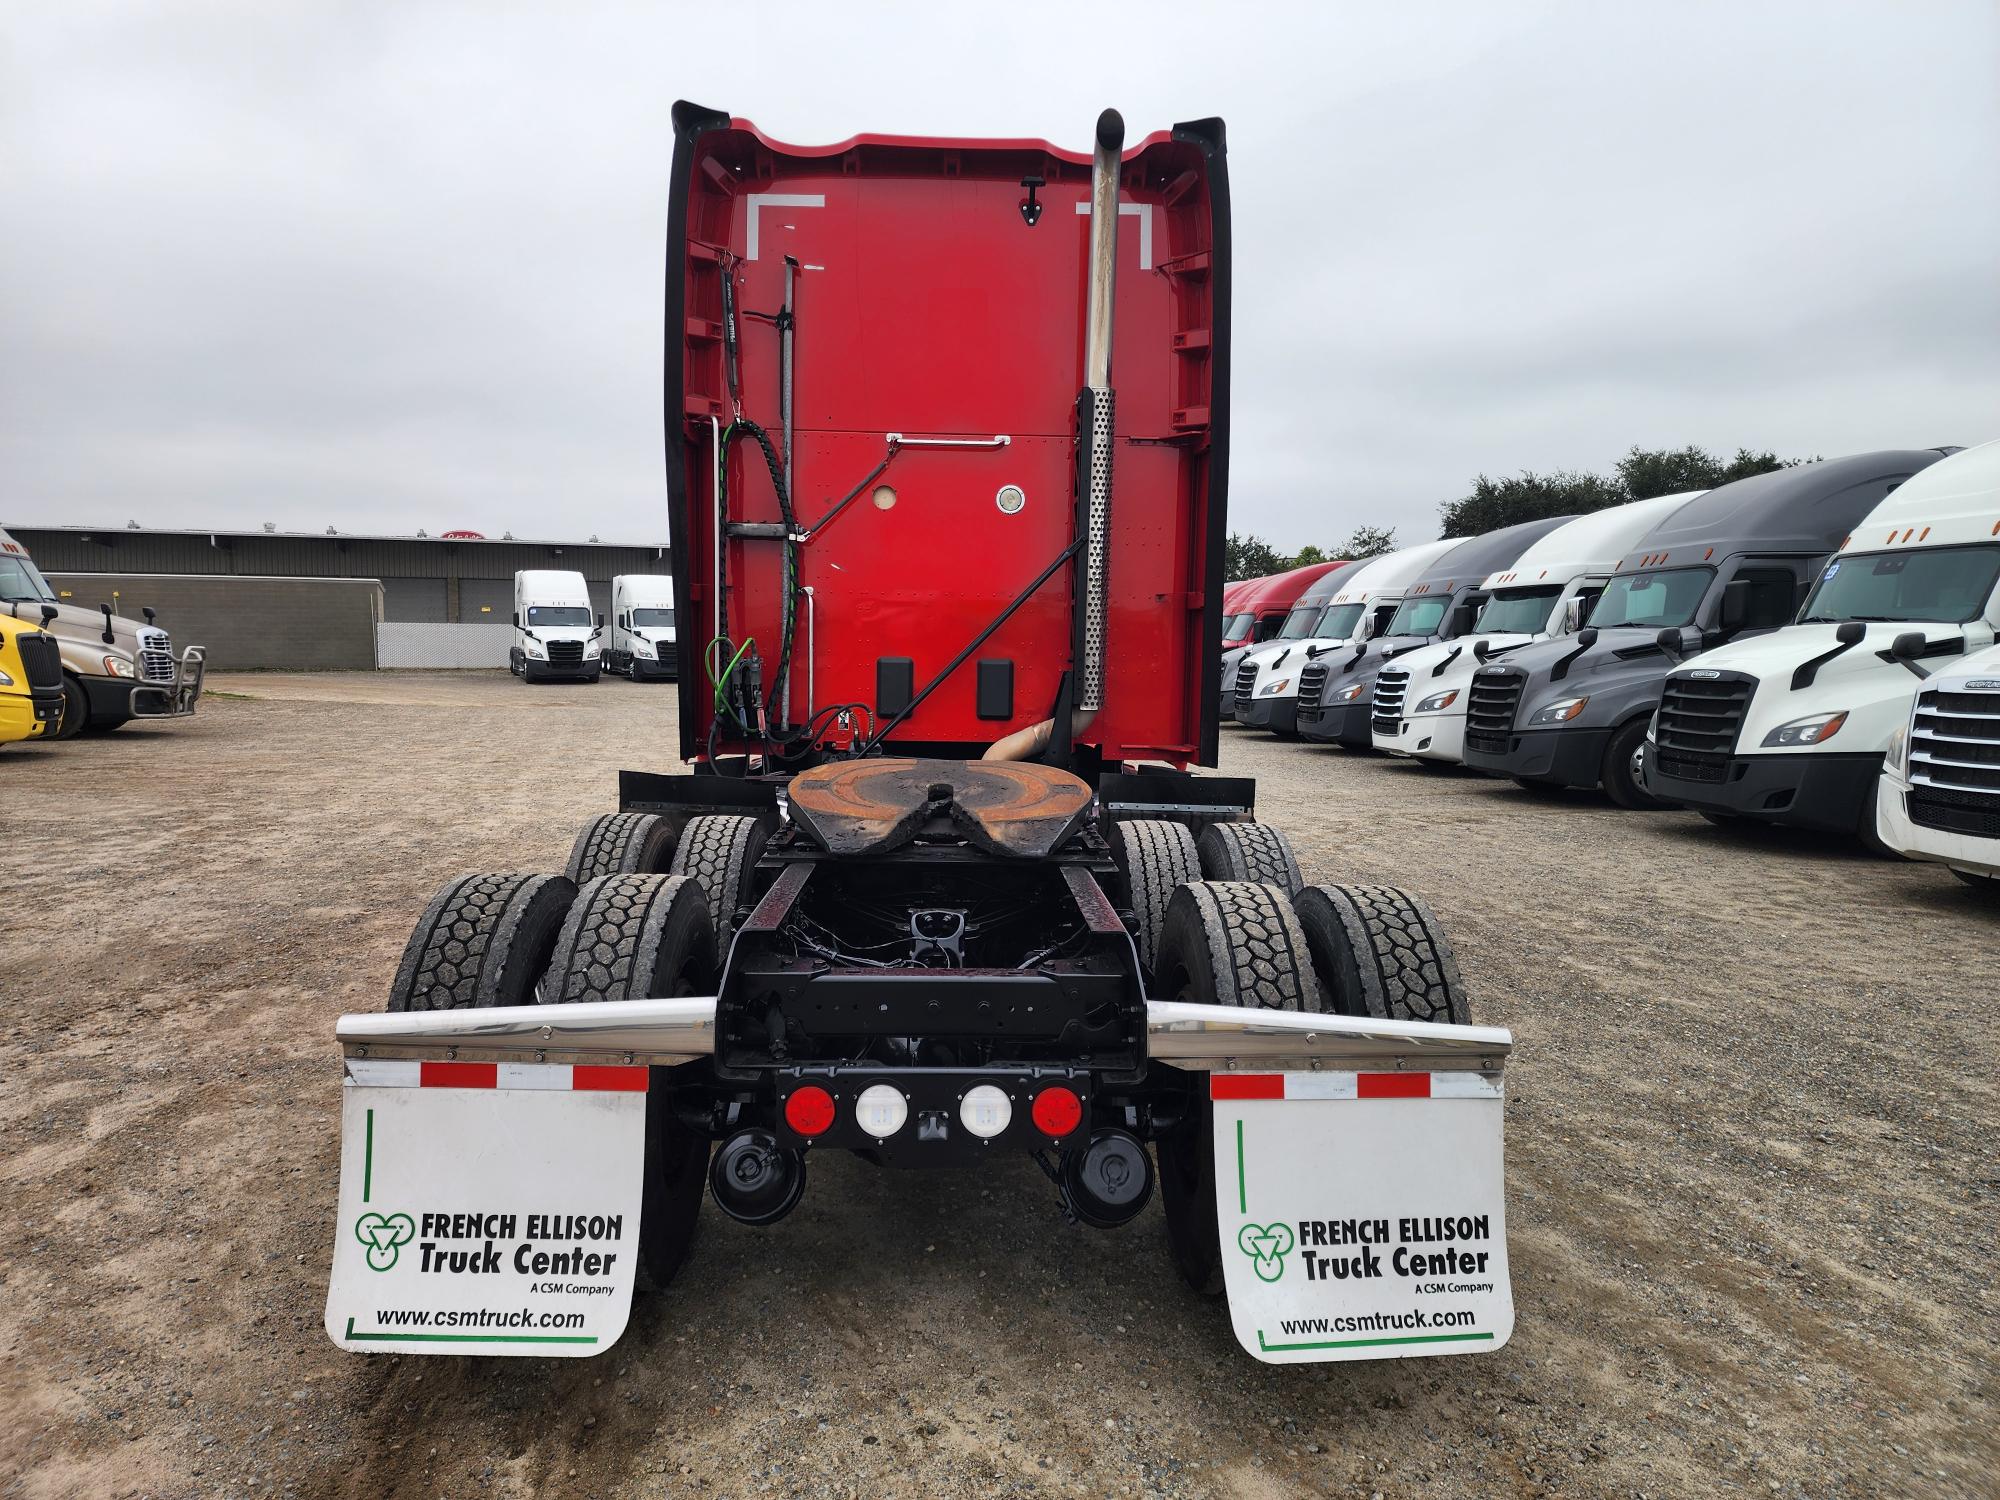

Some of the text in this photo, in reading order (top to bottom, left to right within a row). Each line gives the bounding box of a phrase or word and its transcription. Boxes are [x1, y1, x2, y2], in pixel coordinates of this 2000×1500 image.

[420, 1213, 622, 1241] FRENCH ELLISON
[1299, 1215, 1489, 1246] FRENCH ELLISON
[420, 1241, 616, 1275] Truck Center
[1301, 1246, 1488, 1280] Truck Center
[530, 1283, 614, 1296] A CSM Company
[1415, 1282, 1494, 1294] A CSM Company
[377, 1308, 584, 1328] www.csmtruck.com
[1281, 1309, 1475, 1335] www.csmtruck.com
